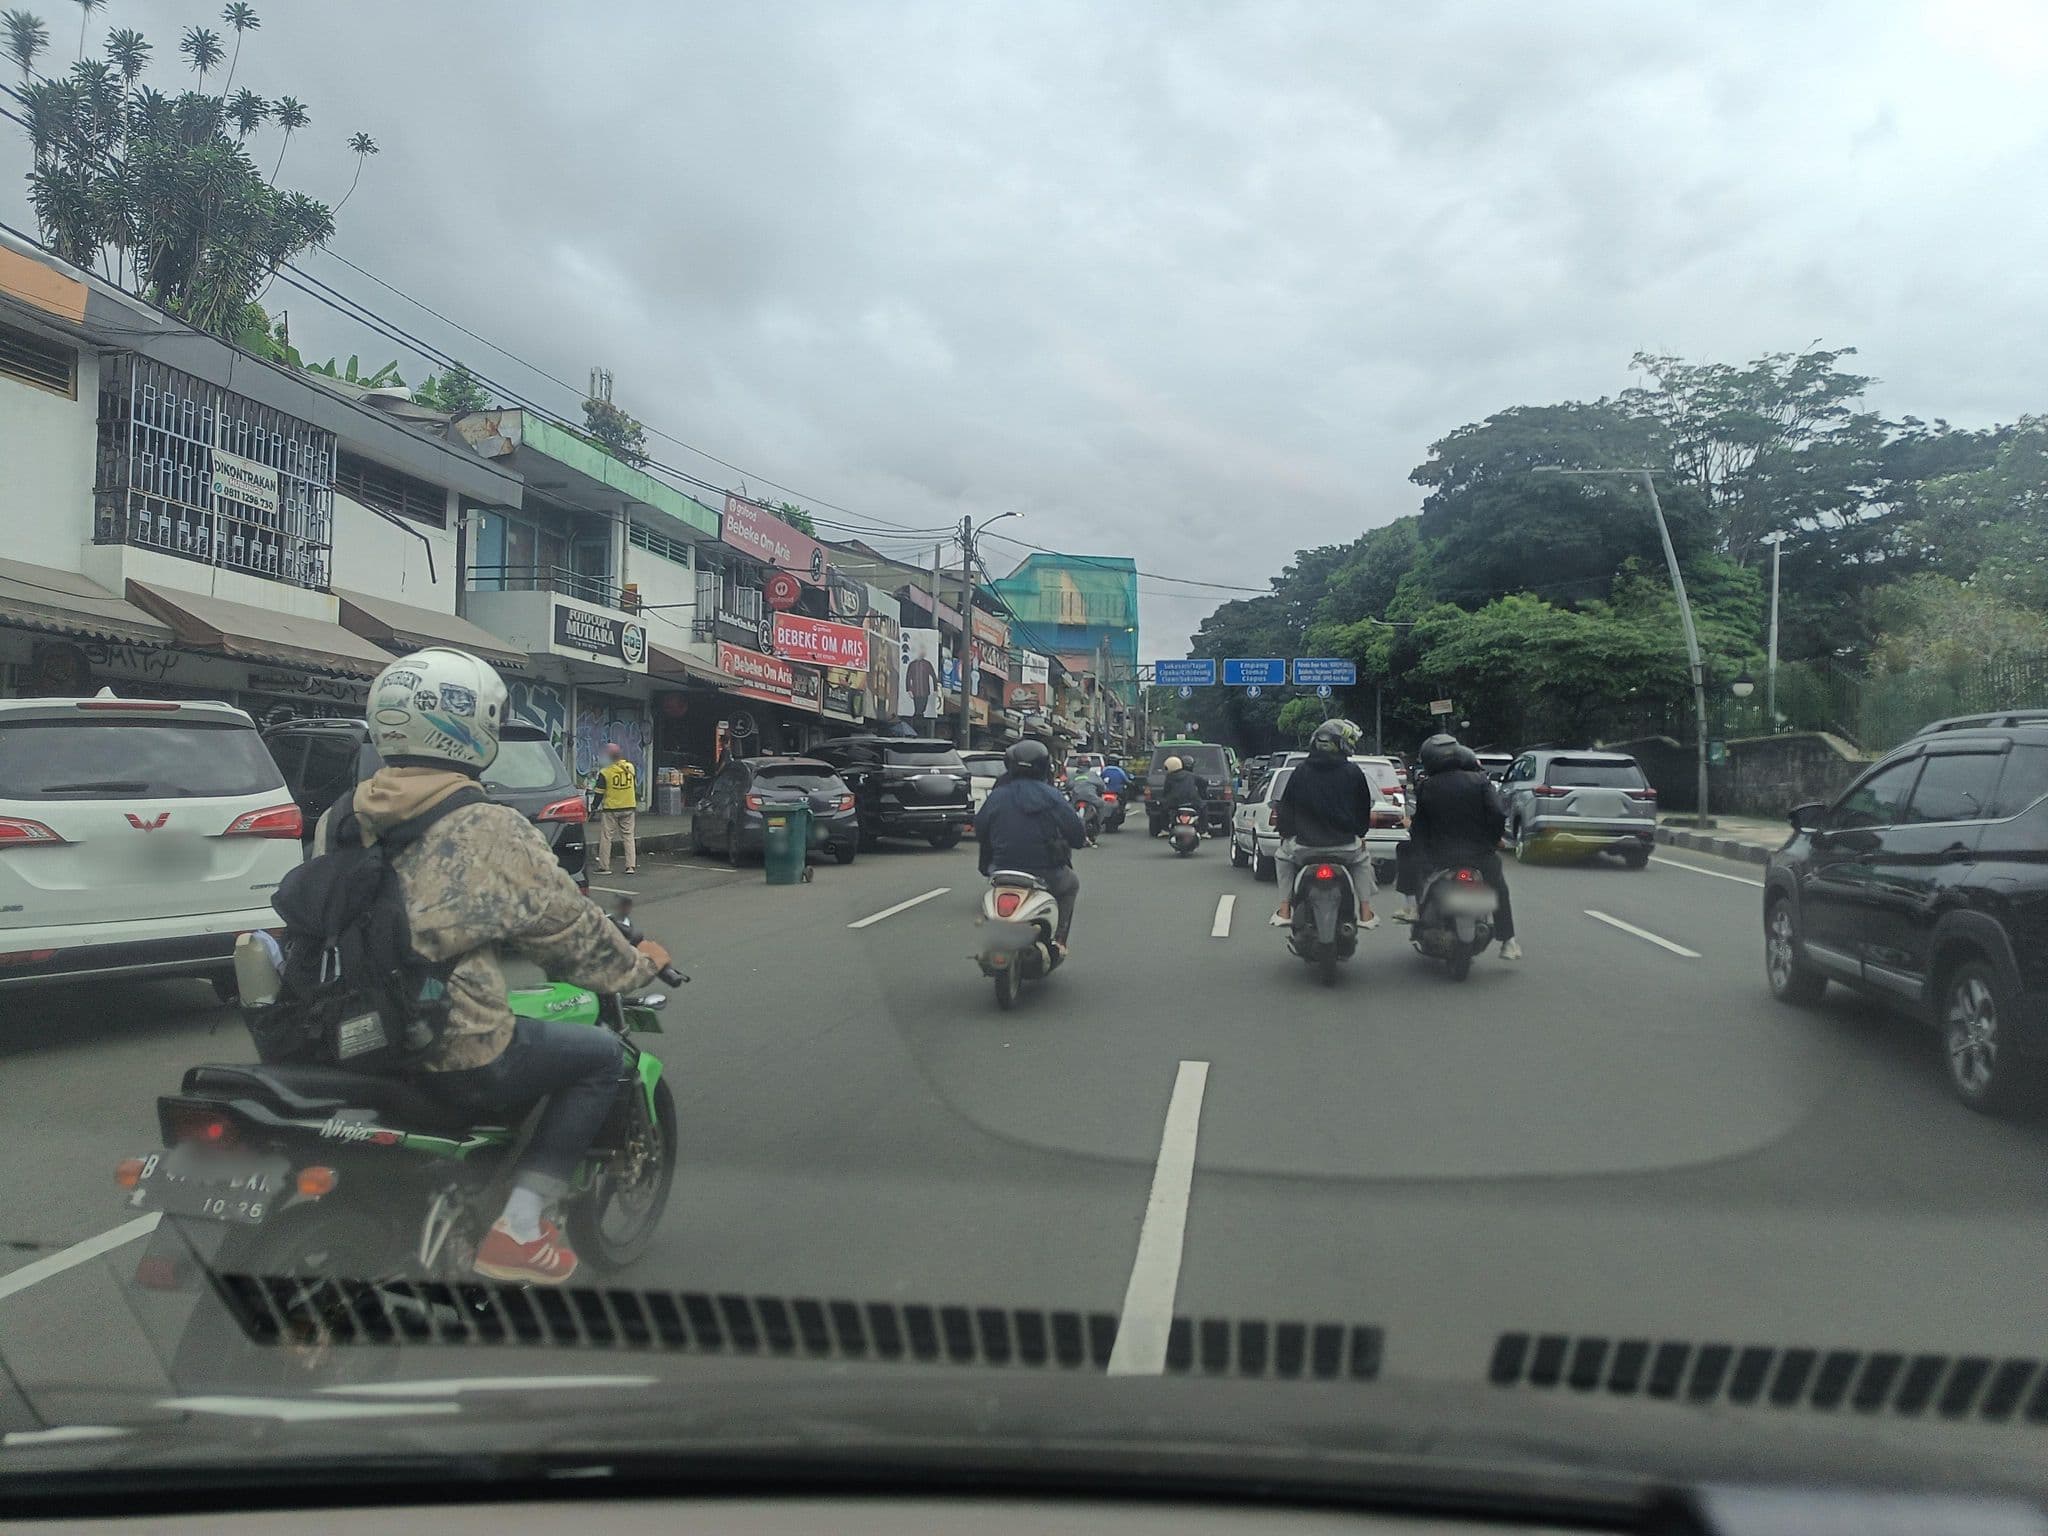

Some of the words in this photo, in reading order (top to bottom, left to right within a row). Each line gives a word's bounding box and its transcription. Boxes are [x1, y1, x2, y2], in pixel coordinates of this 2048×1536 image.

[214, 460, 276, 492] DIKONTRAKAN
[224, 486, 240, 500] 0811
[727, 516, 759, 545] Bebeke
[760, 534, 774, 551] Om
[775, 541, 791, 561] Aris
[566, 620, 616, 645] MUTIARA
[777, 627, 817, 650] BEBEKE
[821, 636, 838, 653] OM
[841, 639, 863, 657] ARIS
[734, 654, 762, 677] Bebeke
[763, 662, 777, 681] Om
[777, 667, 793, 685] Aris
[319, 1118, 370, 1144] Ninja
